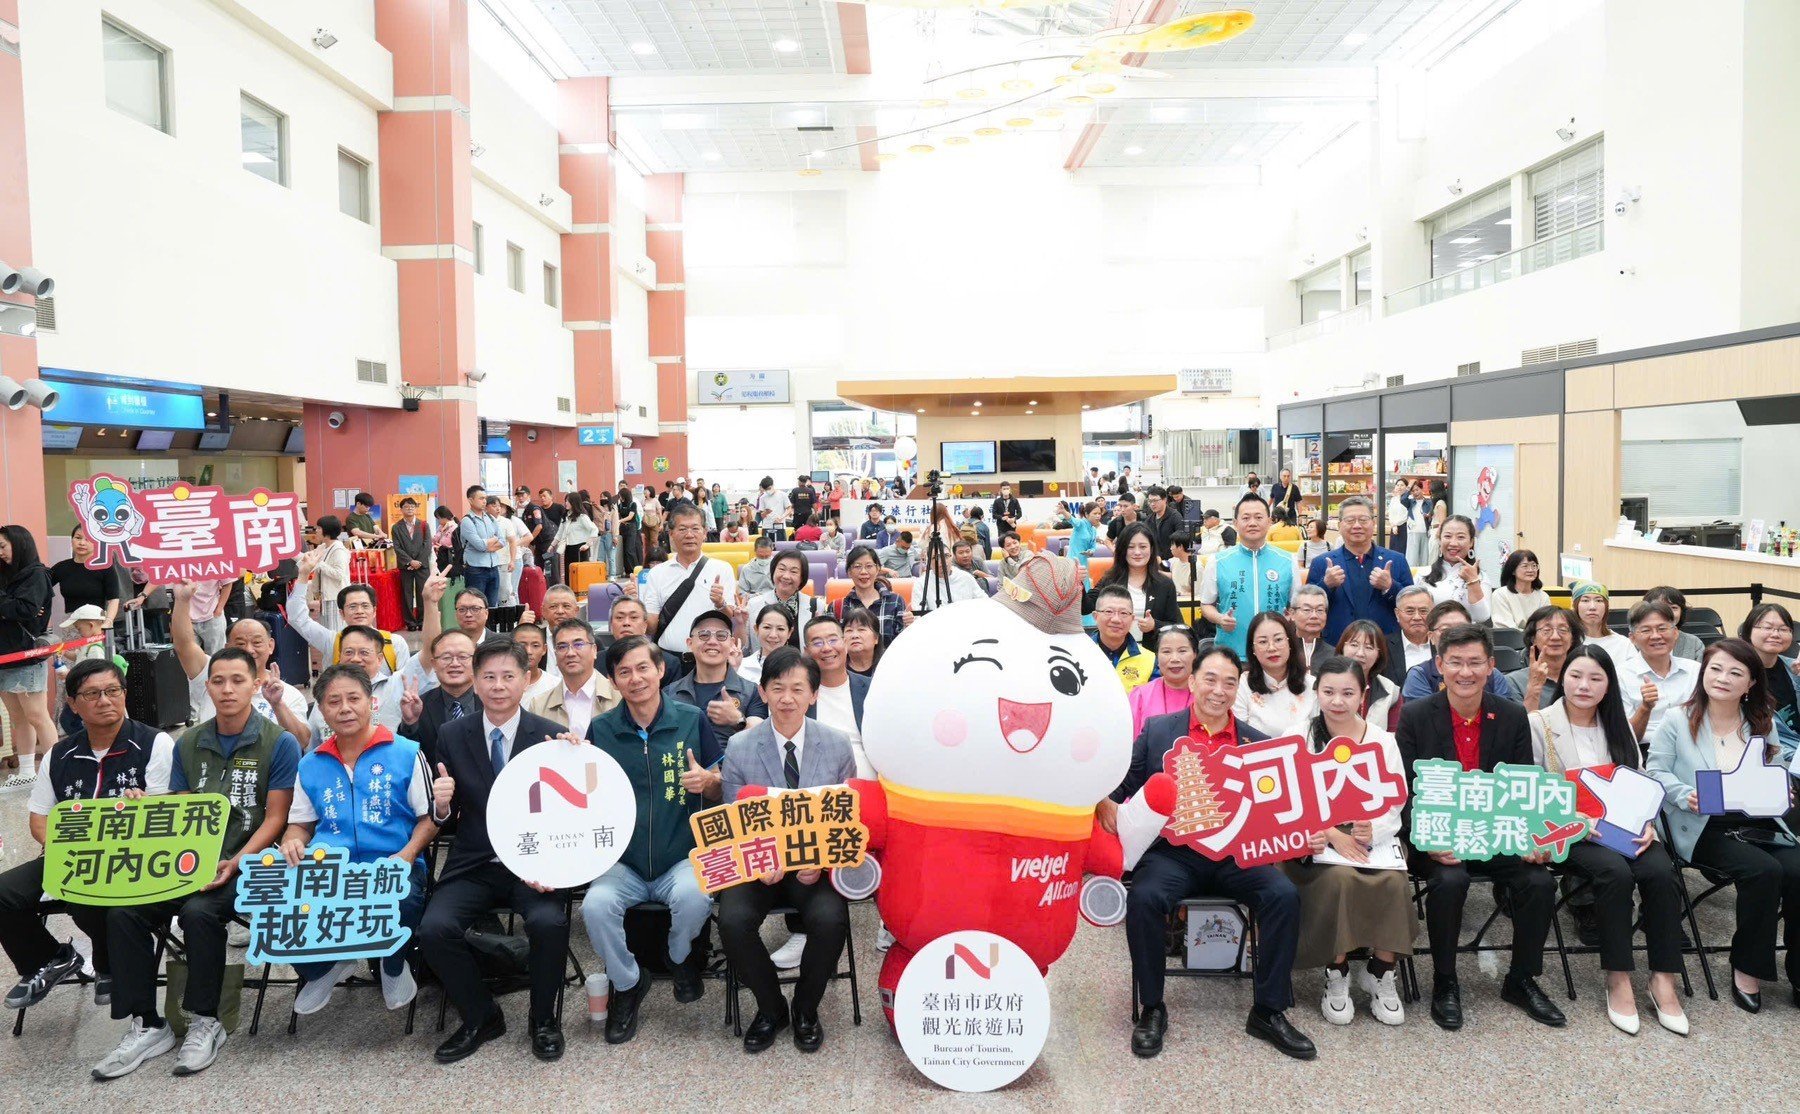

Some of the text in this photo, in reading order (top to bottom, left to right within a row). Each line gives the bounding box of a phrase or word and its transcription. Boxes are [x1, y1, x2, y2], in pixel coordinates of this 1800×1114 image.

[583, 429, 594, 442] 2
[1311, 443, 1319, 452] 2
[129, 486, 295, 569] 臺南
[149, 560, 235, 581] TAINAN
[129, 767, 139, 791] 市議
[335, 777, 346, 802] 主任
[661, 752, 676, 802] 林國華
[1417, 763, 1573, 817] 臺南河內
[1196, 744, 1399, 853] 河內
[52, 799, 223, 845] 臺南直飛
[696, 791, 854, 847] 國際航線
[1416, 810, 1529, 856] 輕鬆飛
[549, 831, 585, 841] TAINAN
[556, 841, 580, 849] CITY
[1241, 829, 1312, 860] HANOI
[60, 848, 201, 887] 河內GO
[696, 827, 864, 890] 臺南出發
[242, 846, 405, 907] 臺南首航
[252, 903, 403, 959] 越好玩
[922, 992, 1024, 1012] 臺南市政府
[922, 1017, 1024, 1036] 觀光旅遊局
[922, 1057, 1025, 1069] Tainan City Government
[933, 1044, 961, 1053] Bureau
[964, 1044, 974, 1053] of
